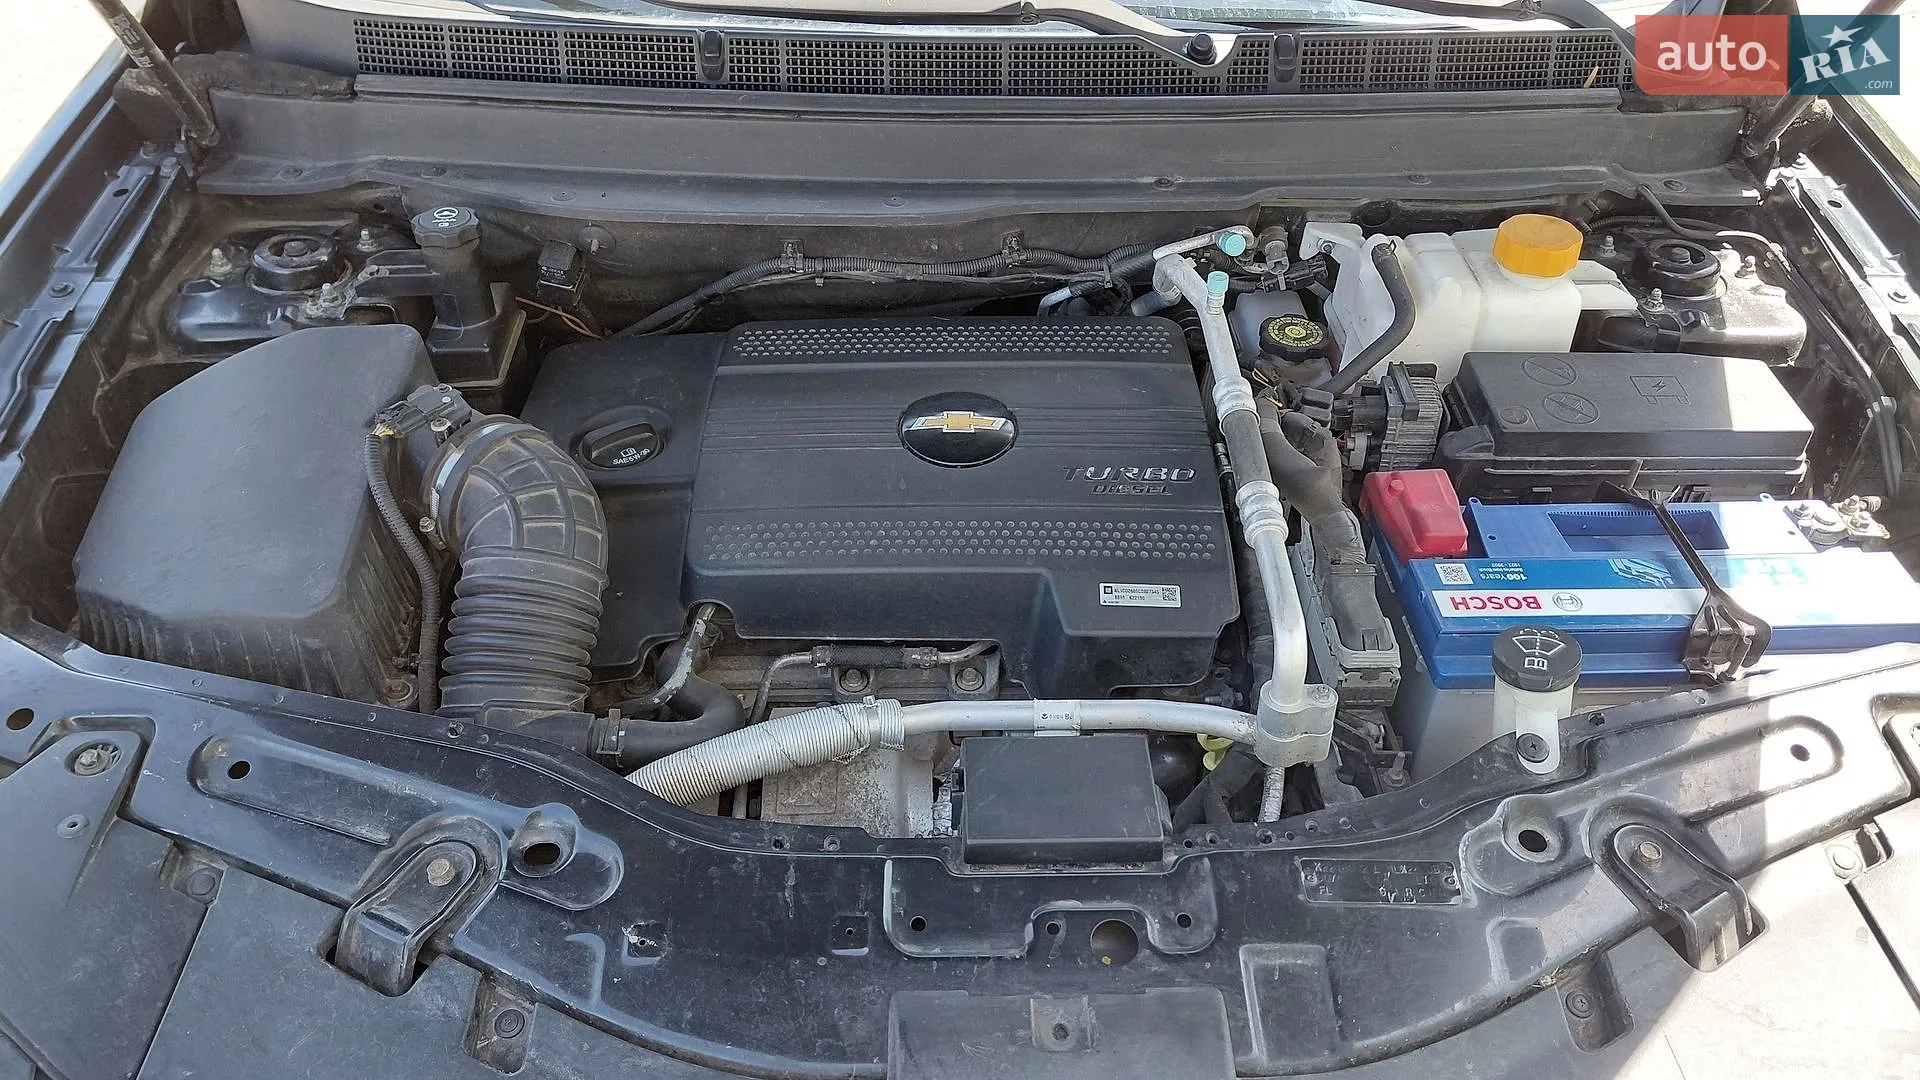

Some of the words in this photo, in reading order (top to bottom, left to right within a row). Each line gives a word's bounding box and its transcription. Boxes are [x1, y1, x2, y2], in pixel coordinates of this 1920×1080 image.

[1062, 466, 1197, 483] TURBO
[1090, 484, 1172, 495] DIESEL
[1449, 596, 1542, 610] BOSCH
